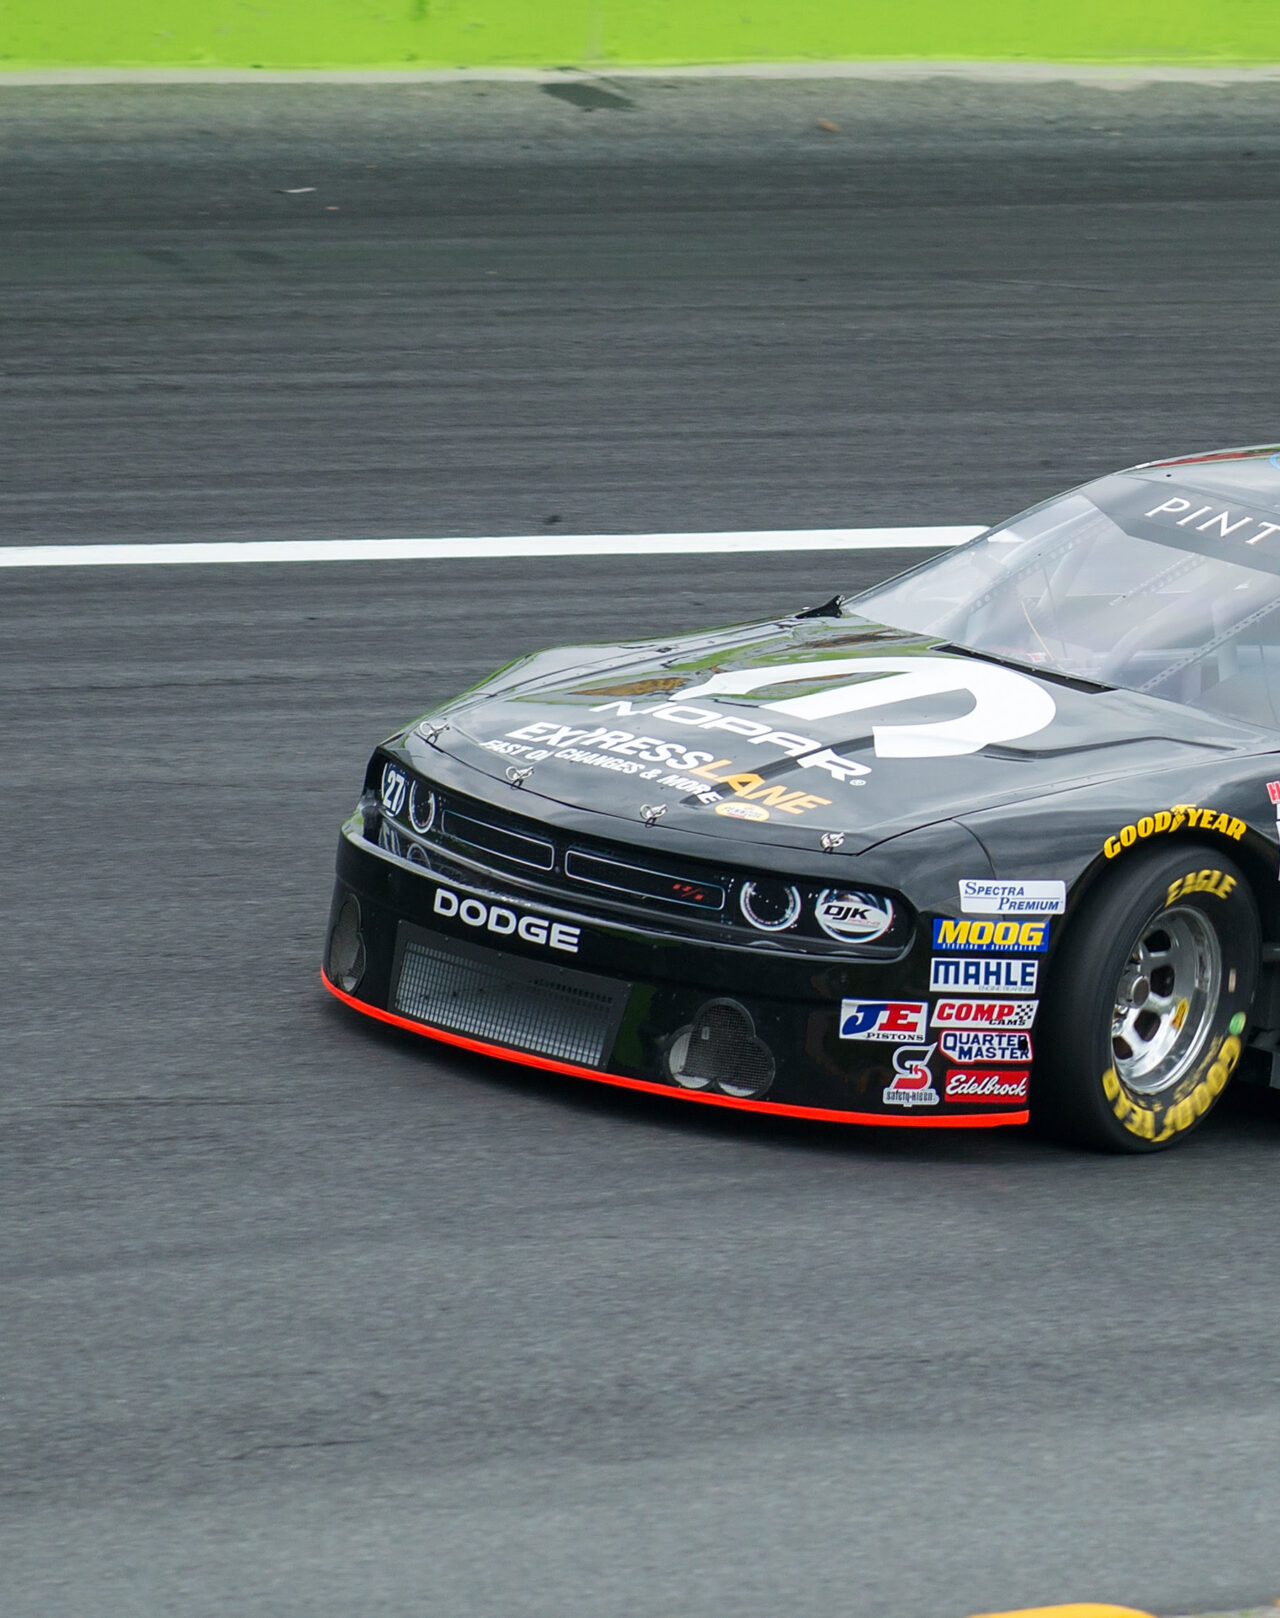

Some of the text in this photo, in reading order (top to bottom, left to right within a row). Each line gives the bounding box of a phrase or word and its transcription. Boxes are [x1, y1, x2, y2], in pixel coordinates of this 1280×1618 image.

[554, 748, 646, 774] CHANGES
[656, 774, 725, 805] MORE
[382, 769, 406, 813] 27
[1103, 804, 1248, 860] GOODYEAR
[964, 881, 1025, 896] SPECTRA
[1164, 869, 1238, 907] EAGLE
[823, 904, 873, 921] DJK
[997, 897, 1060, 911] PREMIUM
[433, 888, 581, 953] DODGE
[937, 920, 1046, 946] MOOG
[933, 960, 1036, 987] MAHLE
[842, 1003, 923, 1036] JE
[936, 1003, 1015, 1021] COMP
[988, 1018, 1026, 1026] CAMS
[865, 1032, 925, 1042] PISTONS
[958, 1046, 1029, 1060] MASTER
[945, 1074, 1027, 1097] Edelbrock
